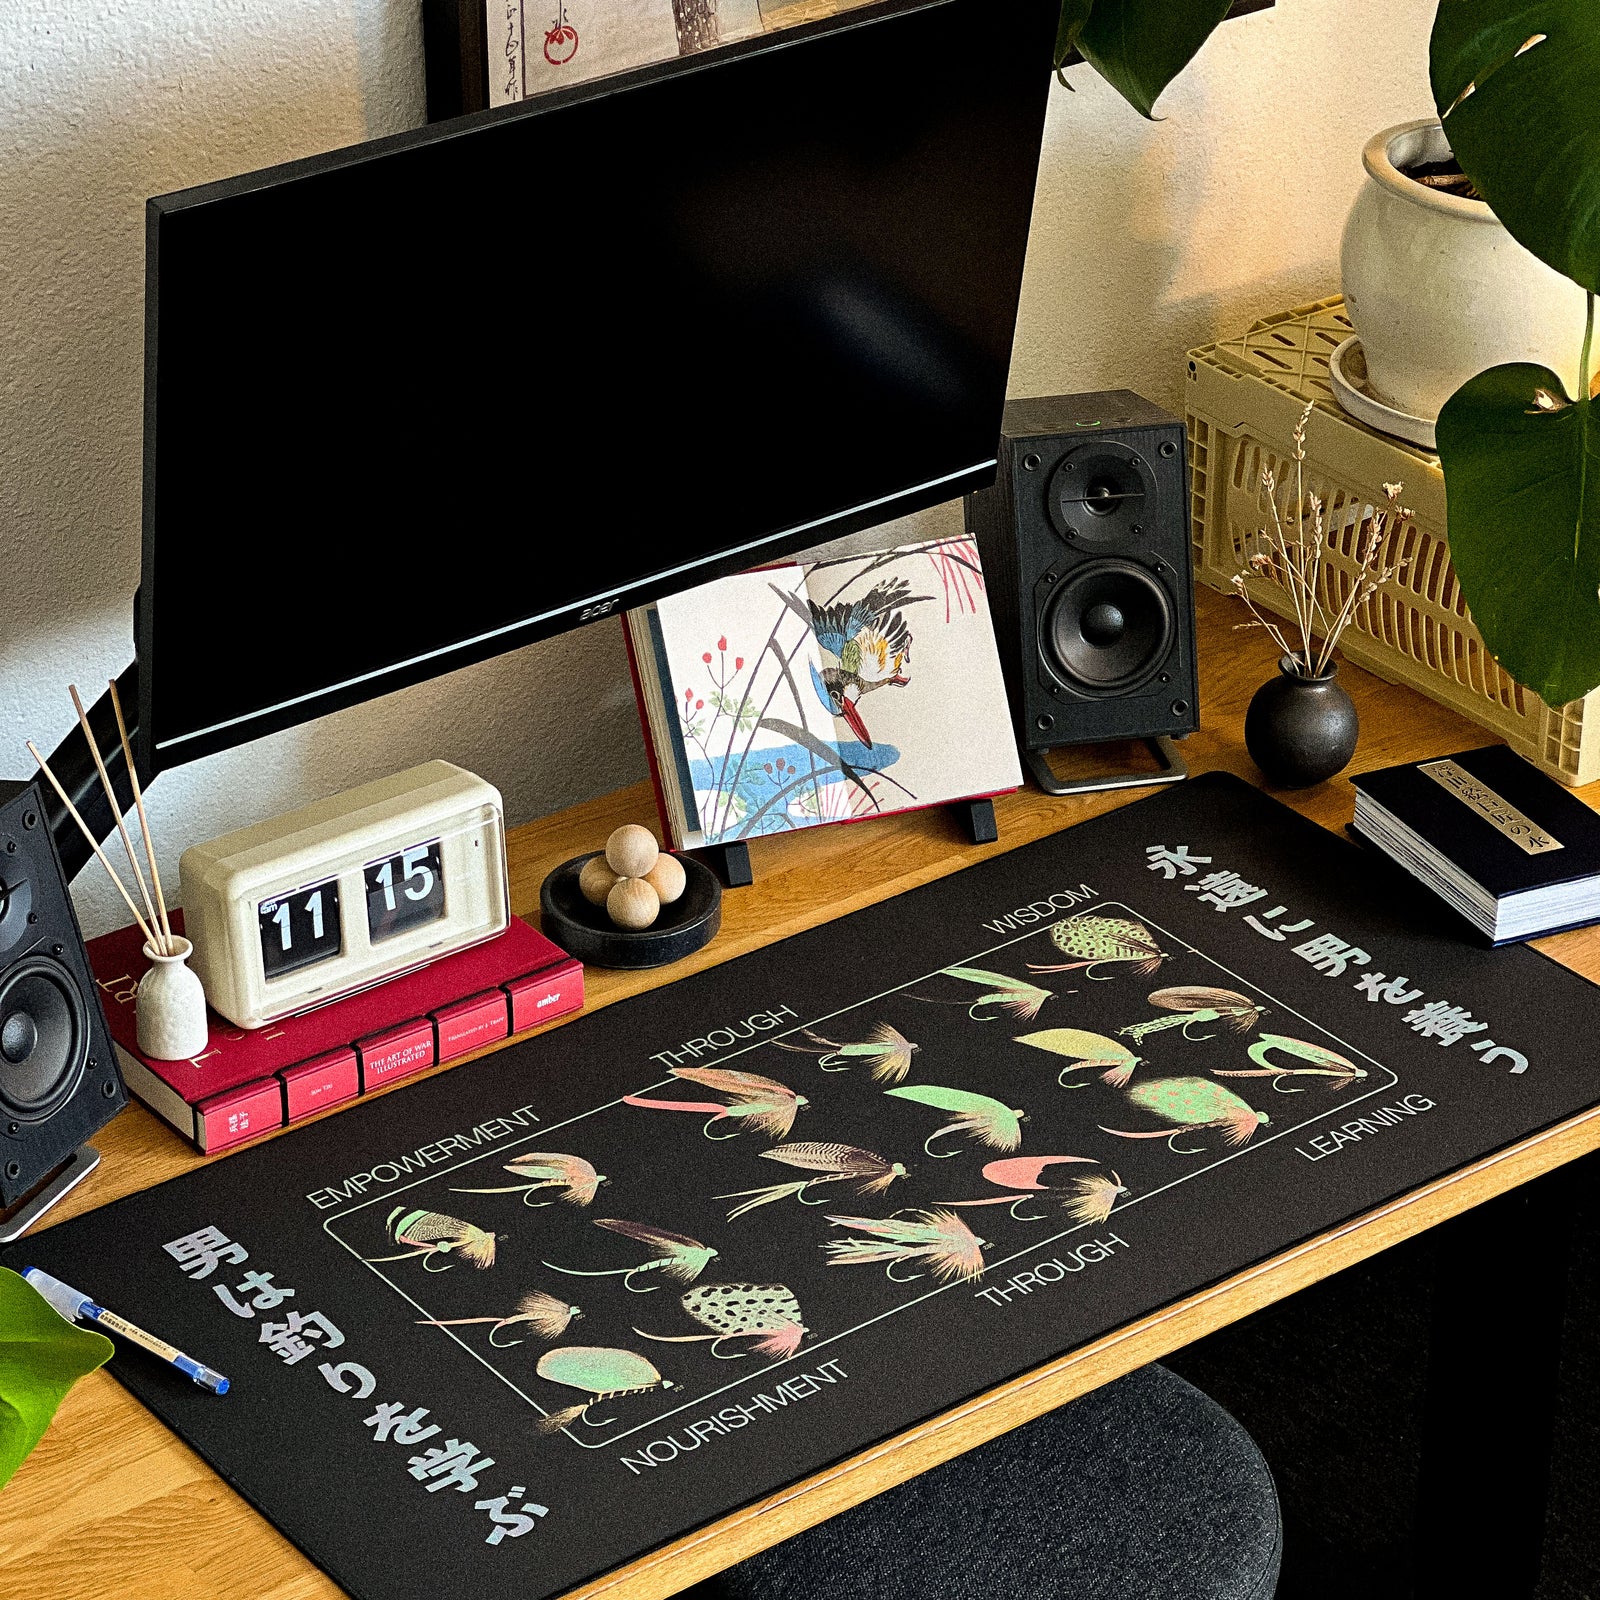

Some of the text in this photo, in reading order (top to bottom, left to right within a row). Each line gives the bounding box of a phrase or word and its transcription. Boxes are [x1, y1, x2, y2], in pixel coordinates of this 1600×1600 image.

[580, 599, 619, 620] acer
[272, 846, 434, 950] 11 15
[982, 883, 1099, 936] WISDOM
[1145, 845, 1529, 1075] 永遠に男を養う
[536, 993, 560, 1008] amber
[369, 1040, 432, 1070] THE ART OF WAR
[376, 1050, 426, 1075] ILLUSTRATED
[649, 1004, 799, 1069] THROUGH
[306, 1104, 543, 1212] EMPOWERMENT
[1294, 1093, 1436, 1162] LEARNING
[975, 1232, 1129, 1307] THROUGH
[162, 1225, 549, 1546] 男は釣りを学ぶ
[620, 1358, 849, 1475] NOURISHMENT
